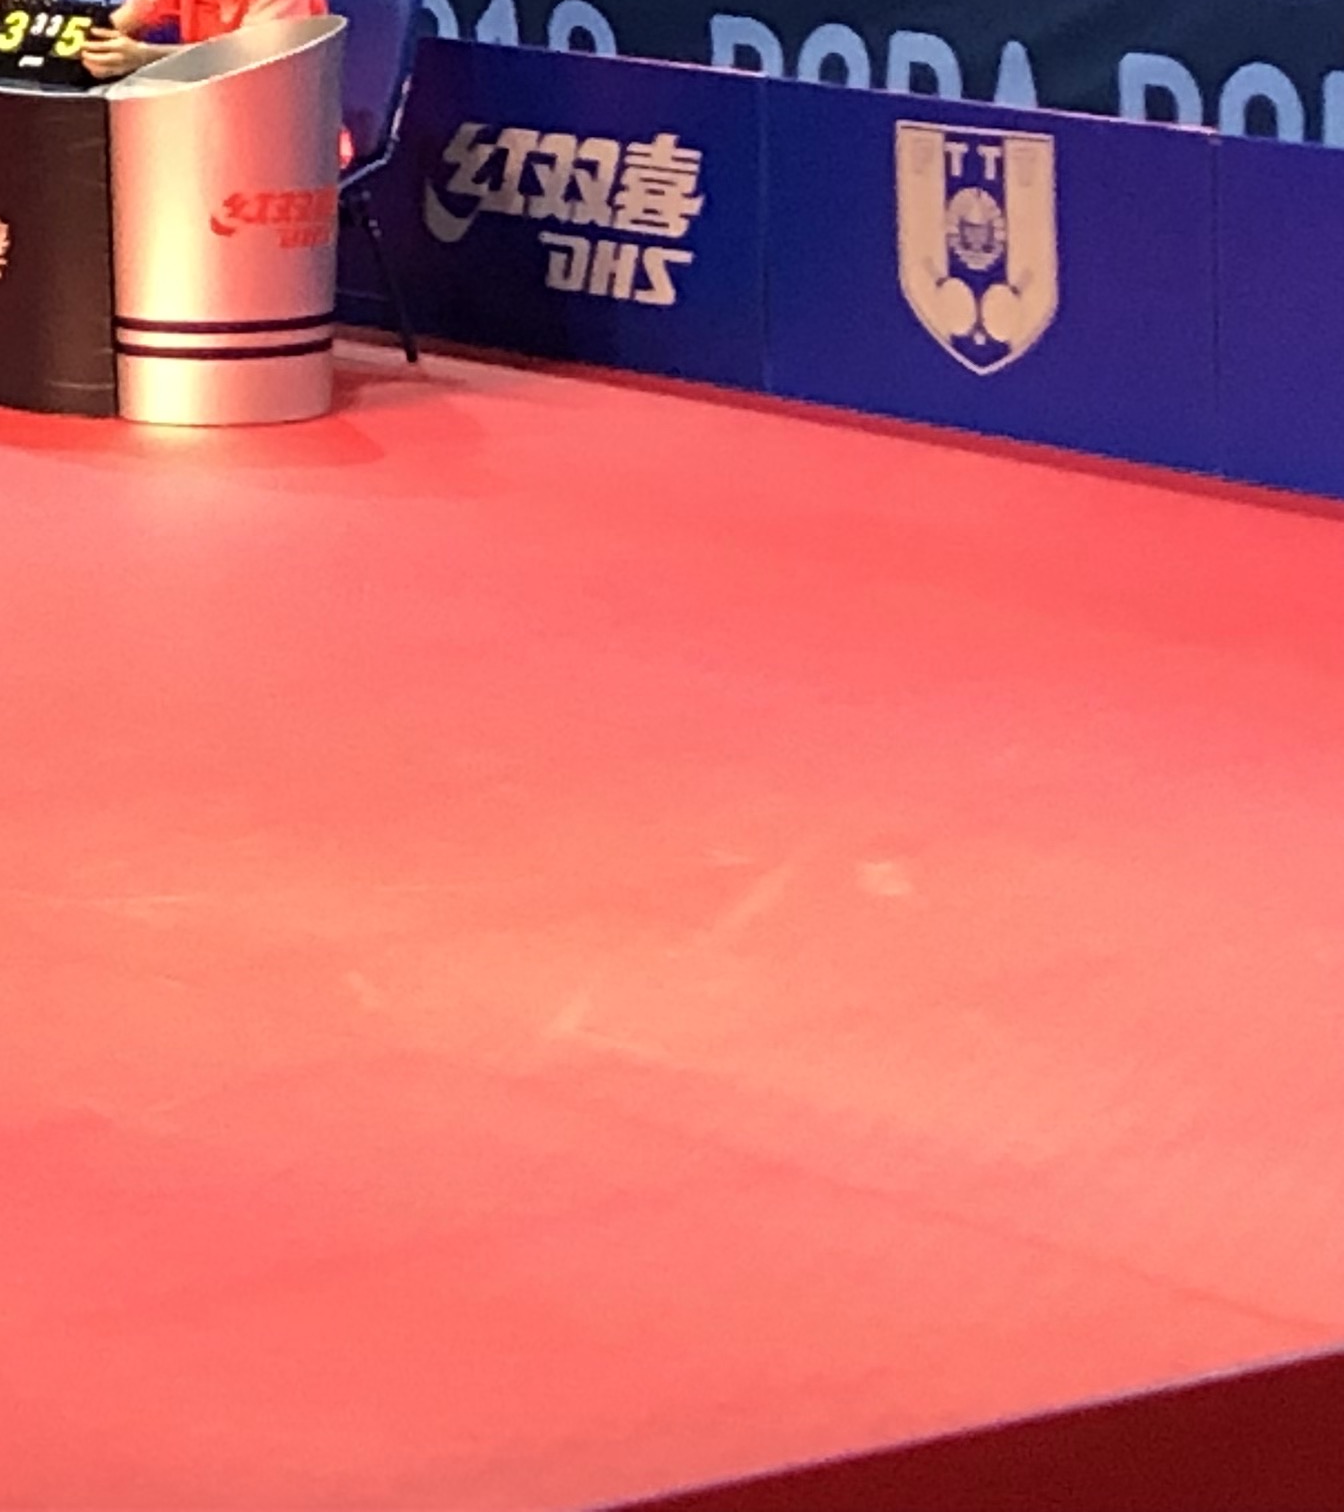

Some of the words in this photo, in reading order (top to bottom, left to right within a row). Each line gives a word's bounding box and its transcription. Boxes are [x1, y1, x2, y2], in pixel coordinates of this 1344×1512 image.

[55, 16, 92, 57] 5
[422, 121, 706, 243] 红双喜
[538, 230, 696, 306] DHS
